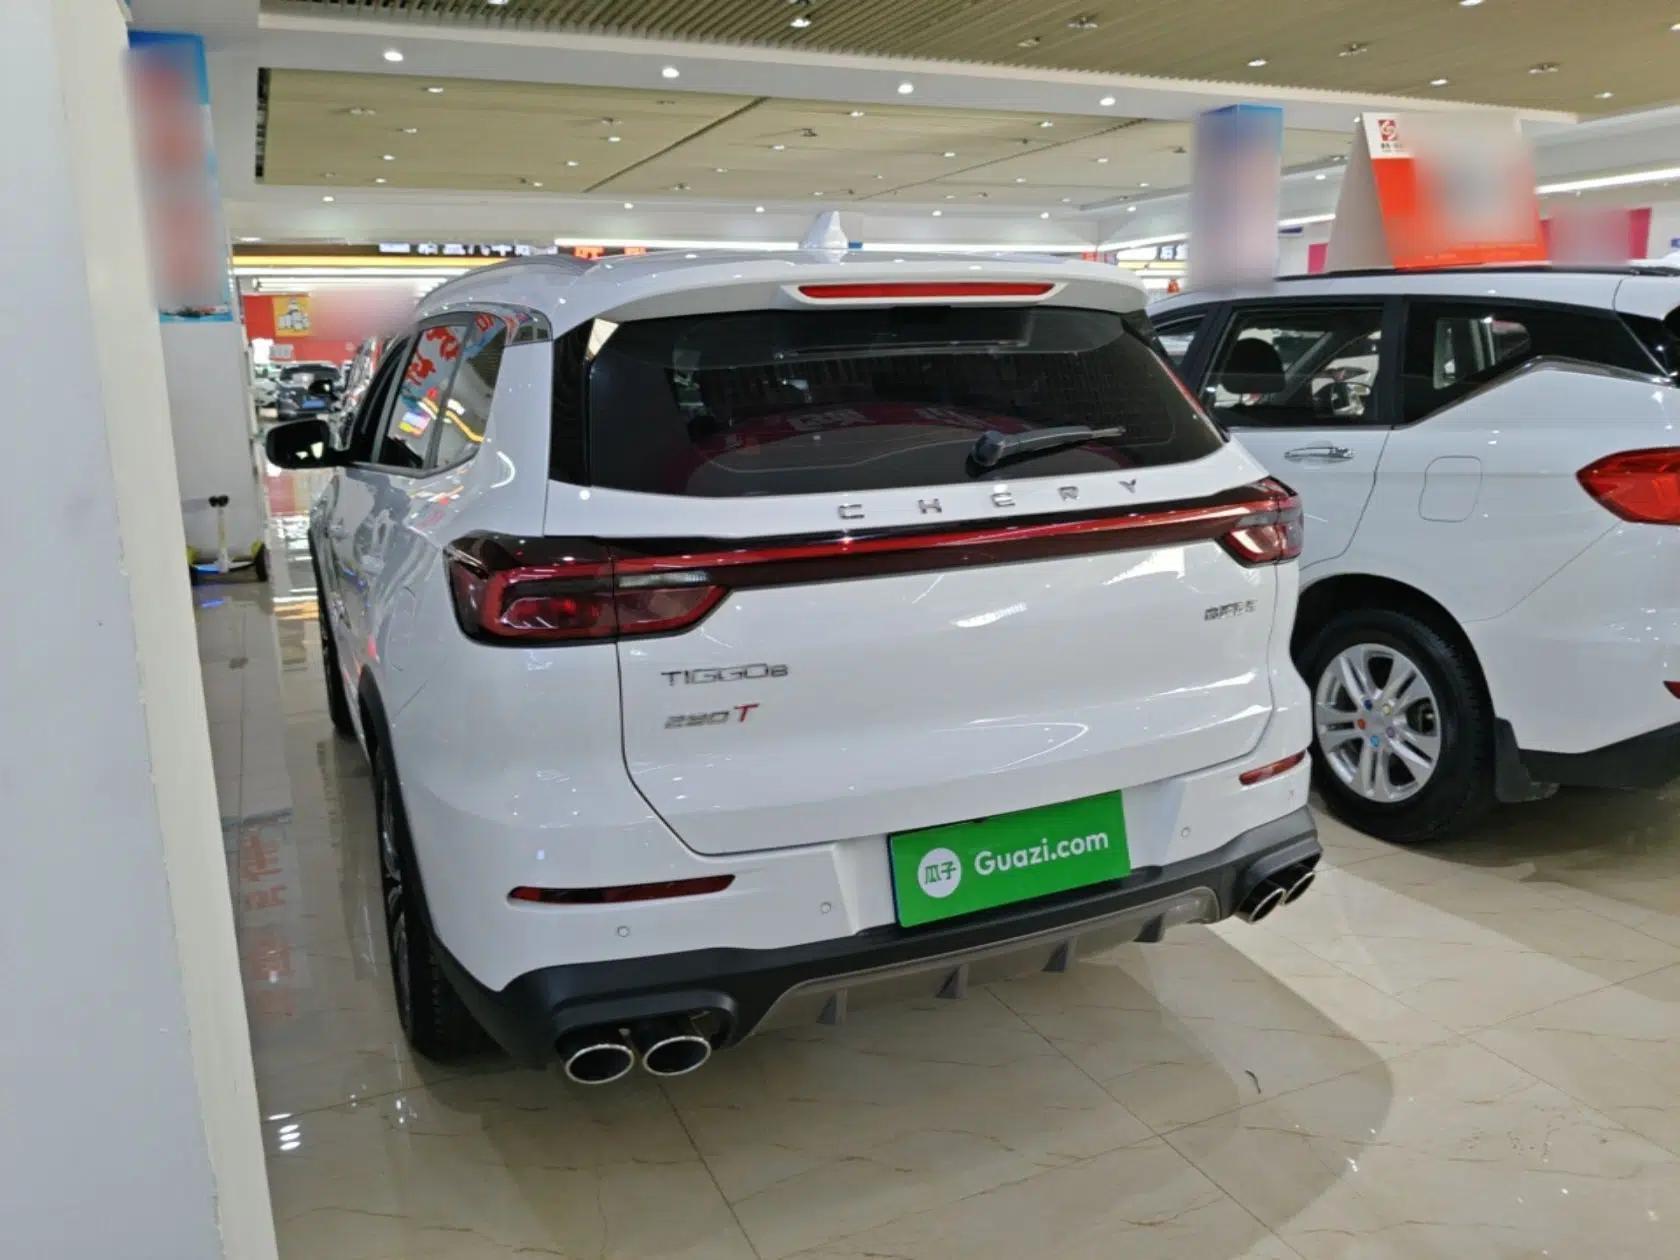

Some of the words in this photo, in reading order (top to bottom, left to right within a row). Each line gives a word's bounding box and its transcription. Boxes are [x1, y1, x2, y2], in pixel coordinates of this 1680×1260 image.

[838, 479, 1137, 520] CHERY
[924, 860, 957, 884] 瓜子
[974, 831, 1109, 876] Guazi.com
